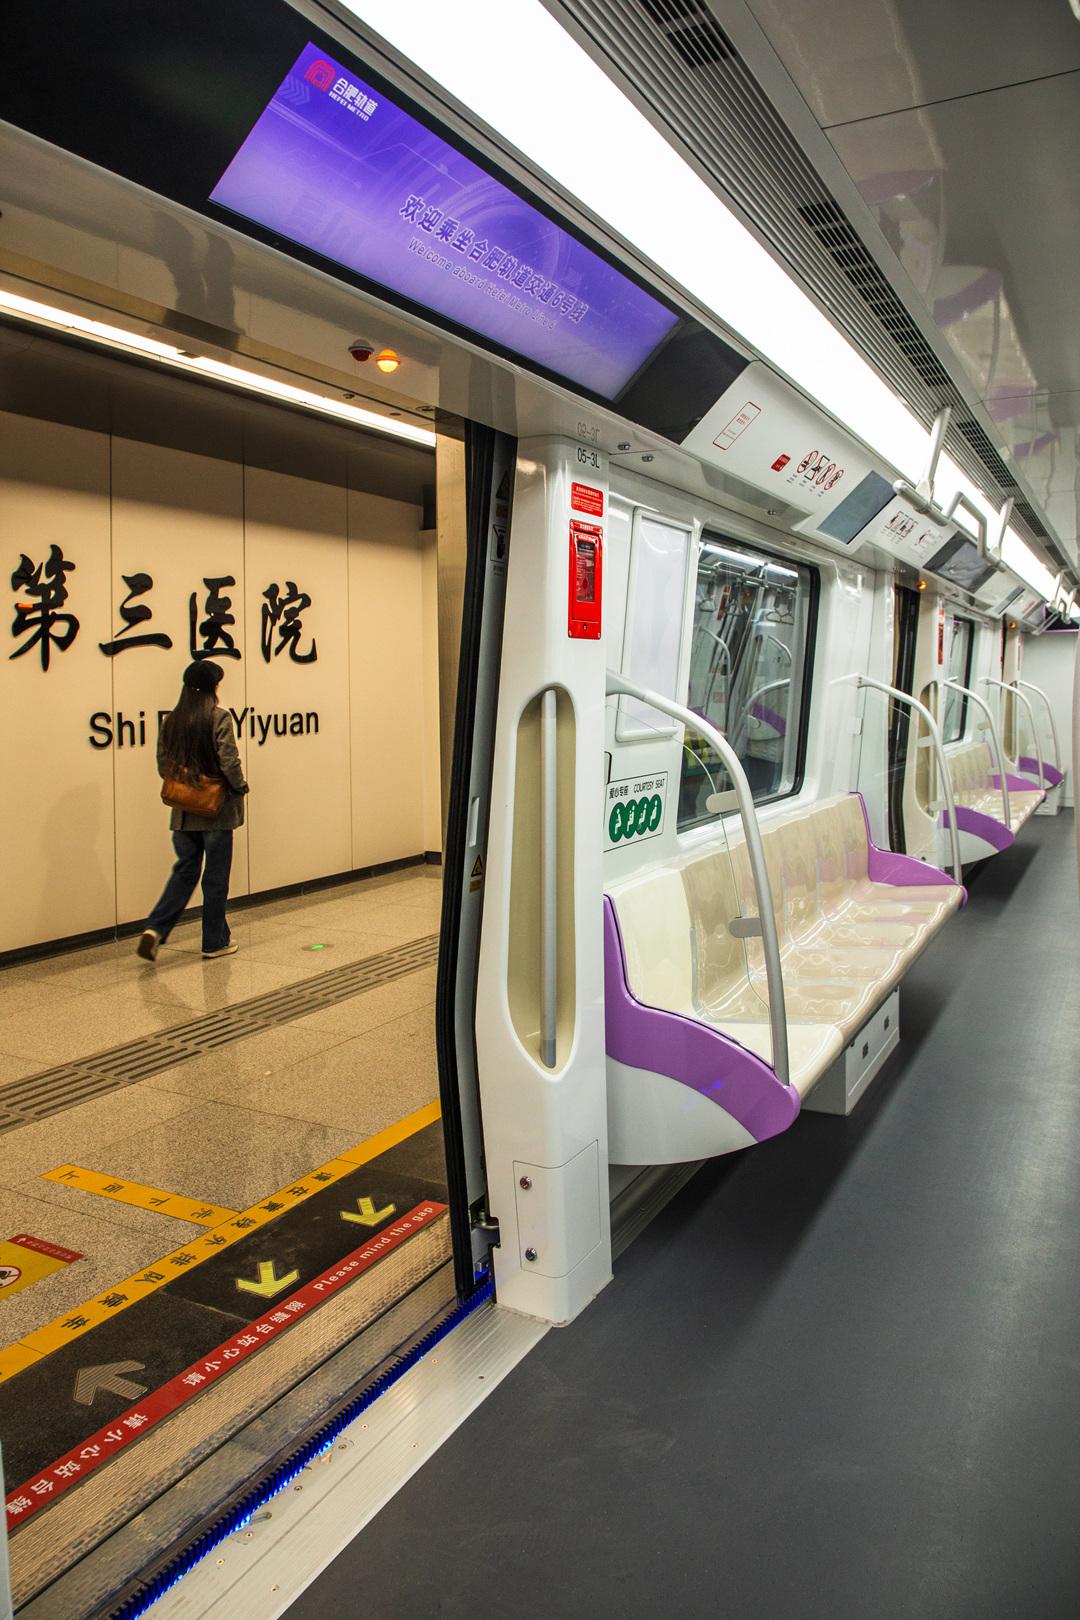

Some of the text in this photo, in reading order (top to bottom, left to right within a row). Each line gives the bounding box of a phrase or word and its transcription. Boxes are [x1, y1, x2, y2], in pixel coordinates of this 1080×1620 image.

[328, 91, 370, 122] HEFEI METRO
[333, 78, 378, 116] 合肥轨道
[400, 194, 589, 324] 欢迎乘坐合肥轨道交通6号线
[408, 238, 453, 271] Welcome
[453, 265, 487, 289] aboard
[486, 281, 511, 303] Hefei
[508, 296, 533, 317] Metro
[577, 447, 600, 469] 05-3L
[9, 544, 318, 672] 第三医院
[89, 711, 146, 749] Shi
[229, 707, 319, 746] Yiyuan
[58, 1170, 215, 1219] 先下后上
[60, 1171, 335, 1331] 请在黄线外排队候车
[182, 1206, 433, 1386] 请小心站台缝隙 Please mind the gap
